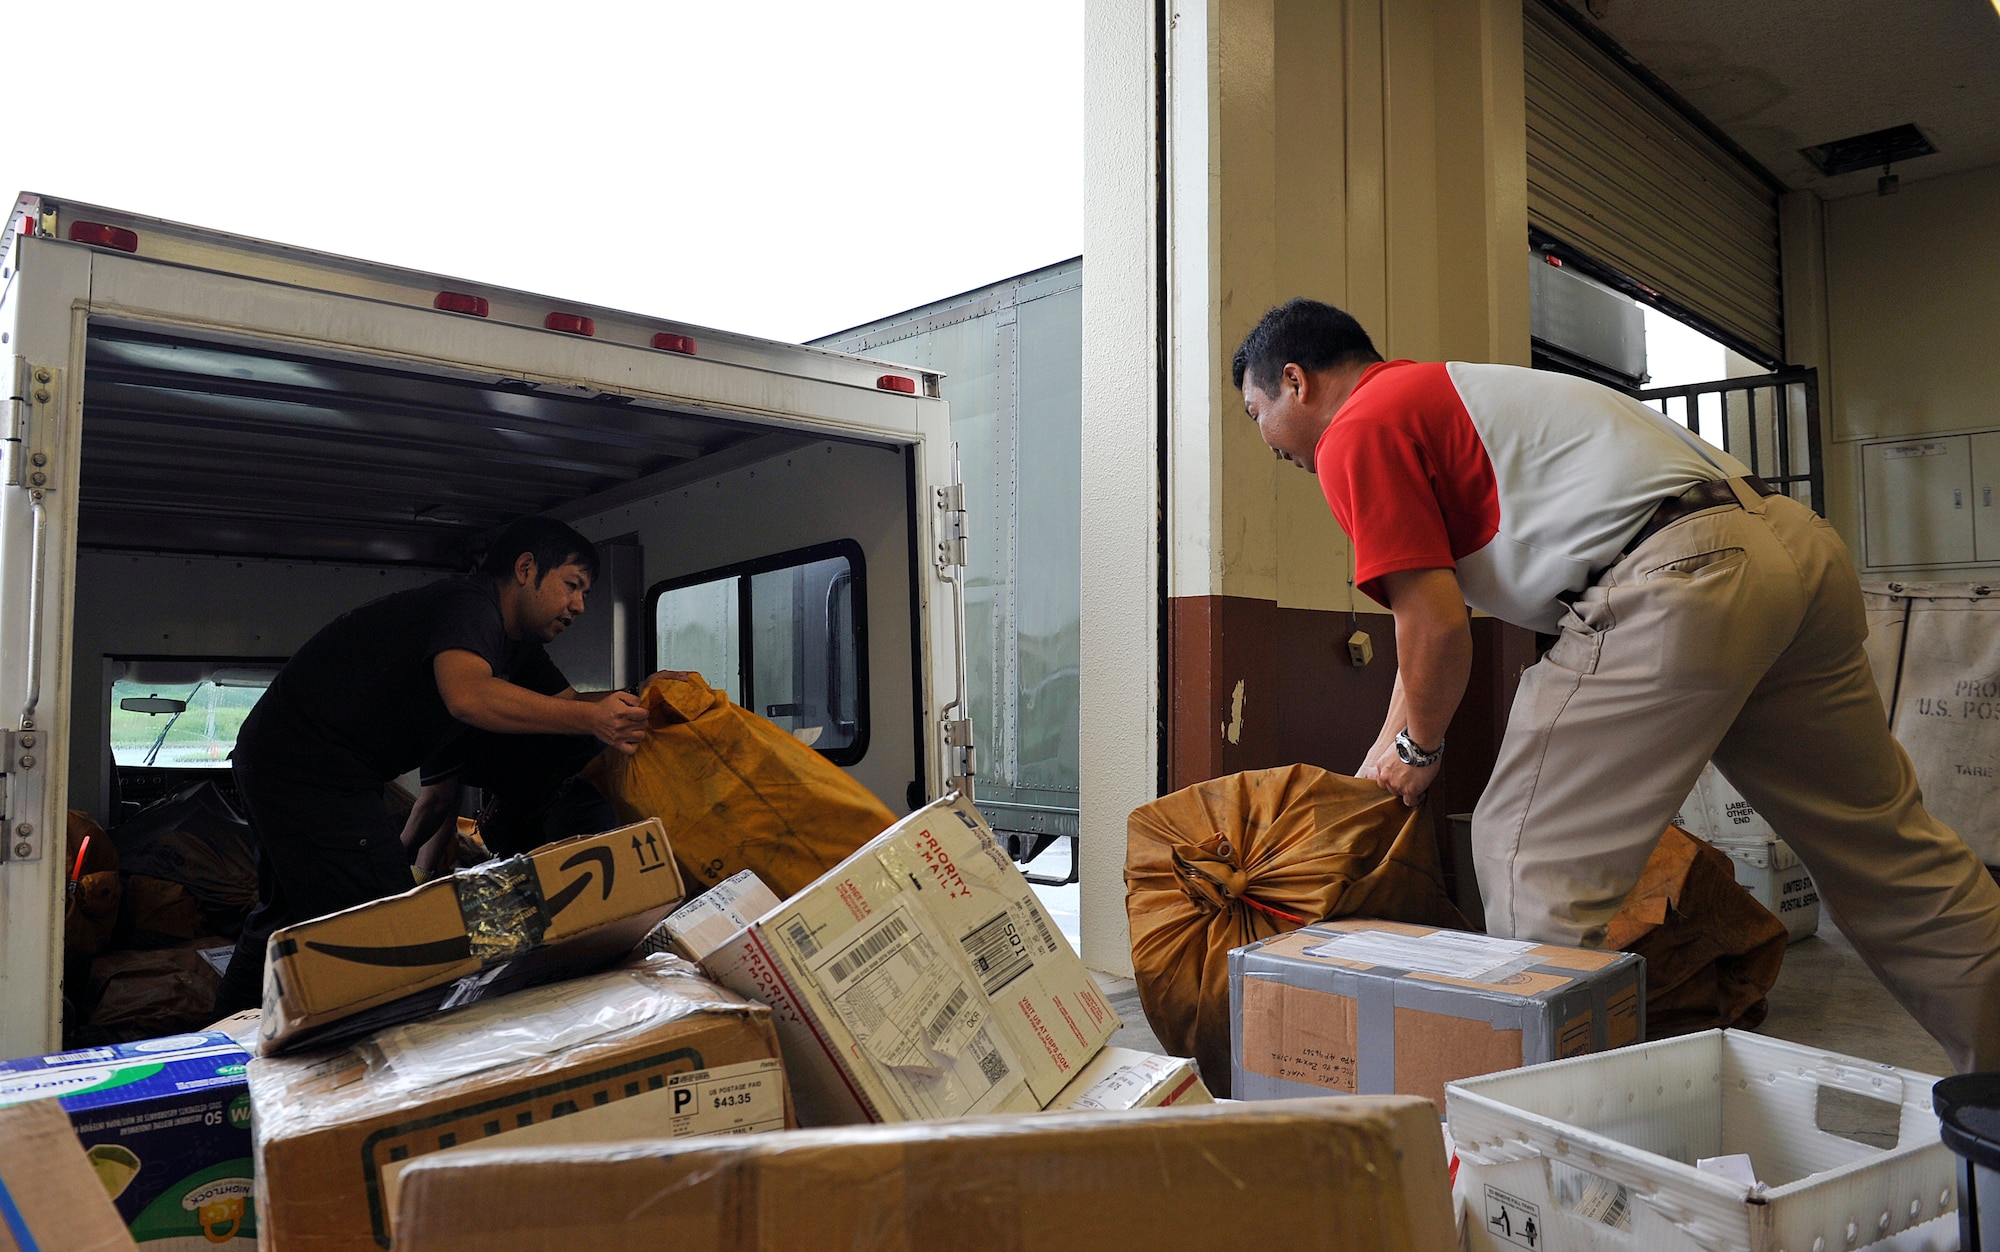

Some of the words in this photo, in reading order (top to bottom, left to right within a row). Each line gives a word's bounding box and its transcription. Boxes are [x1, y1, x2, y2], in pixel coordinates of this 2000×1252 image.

[1955, 680, 2000, 697] PRO
[1920, 698, 1952, 717] U.S.
[1955, 765, 1992, 777] TARE
[1726, 801, 1751, 810] LABEL
[1726, 808, 1754, 818] OTHER
[977, 826, 993, 848] UNITED
[990, 846, 1009, 867] STATES
[919, 829, 970, 897] PRIORITY
[921, 852, 948, 889] MAIL
[1783, 879, 1801, 894] UNITED
[843, 877, 862, 901] LARGE
[859, 900, 872, 915] FLA
[1780, 896, 1801, 912] POSTAL
[1002, 922, 1026, 956] SQI
[743, 942, 799, 1020] PRIORITY
[747, 966, 778, 1009] MAIL
[1020, 996, 1035, 1015] VISIT
[1032, 1014, 1042, 1025] US
[1038, 1024, 1047, 1035] AT
[1028, 1018, 1038, 1032] FREE
[719, 1084, 747, 1094] POSTAGE
[674, 1089, 692, 1114] P
[714, 1093, 751, 1108] $43.35
[135, 1114, 143, 1122] DE
[203, 1110, 223, 1125] 50
[190, 1186, 249, 1204] NIGHTLOCK
[1494, 1191, 1510, 1201] REMOVE
